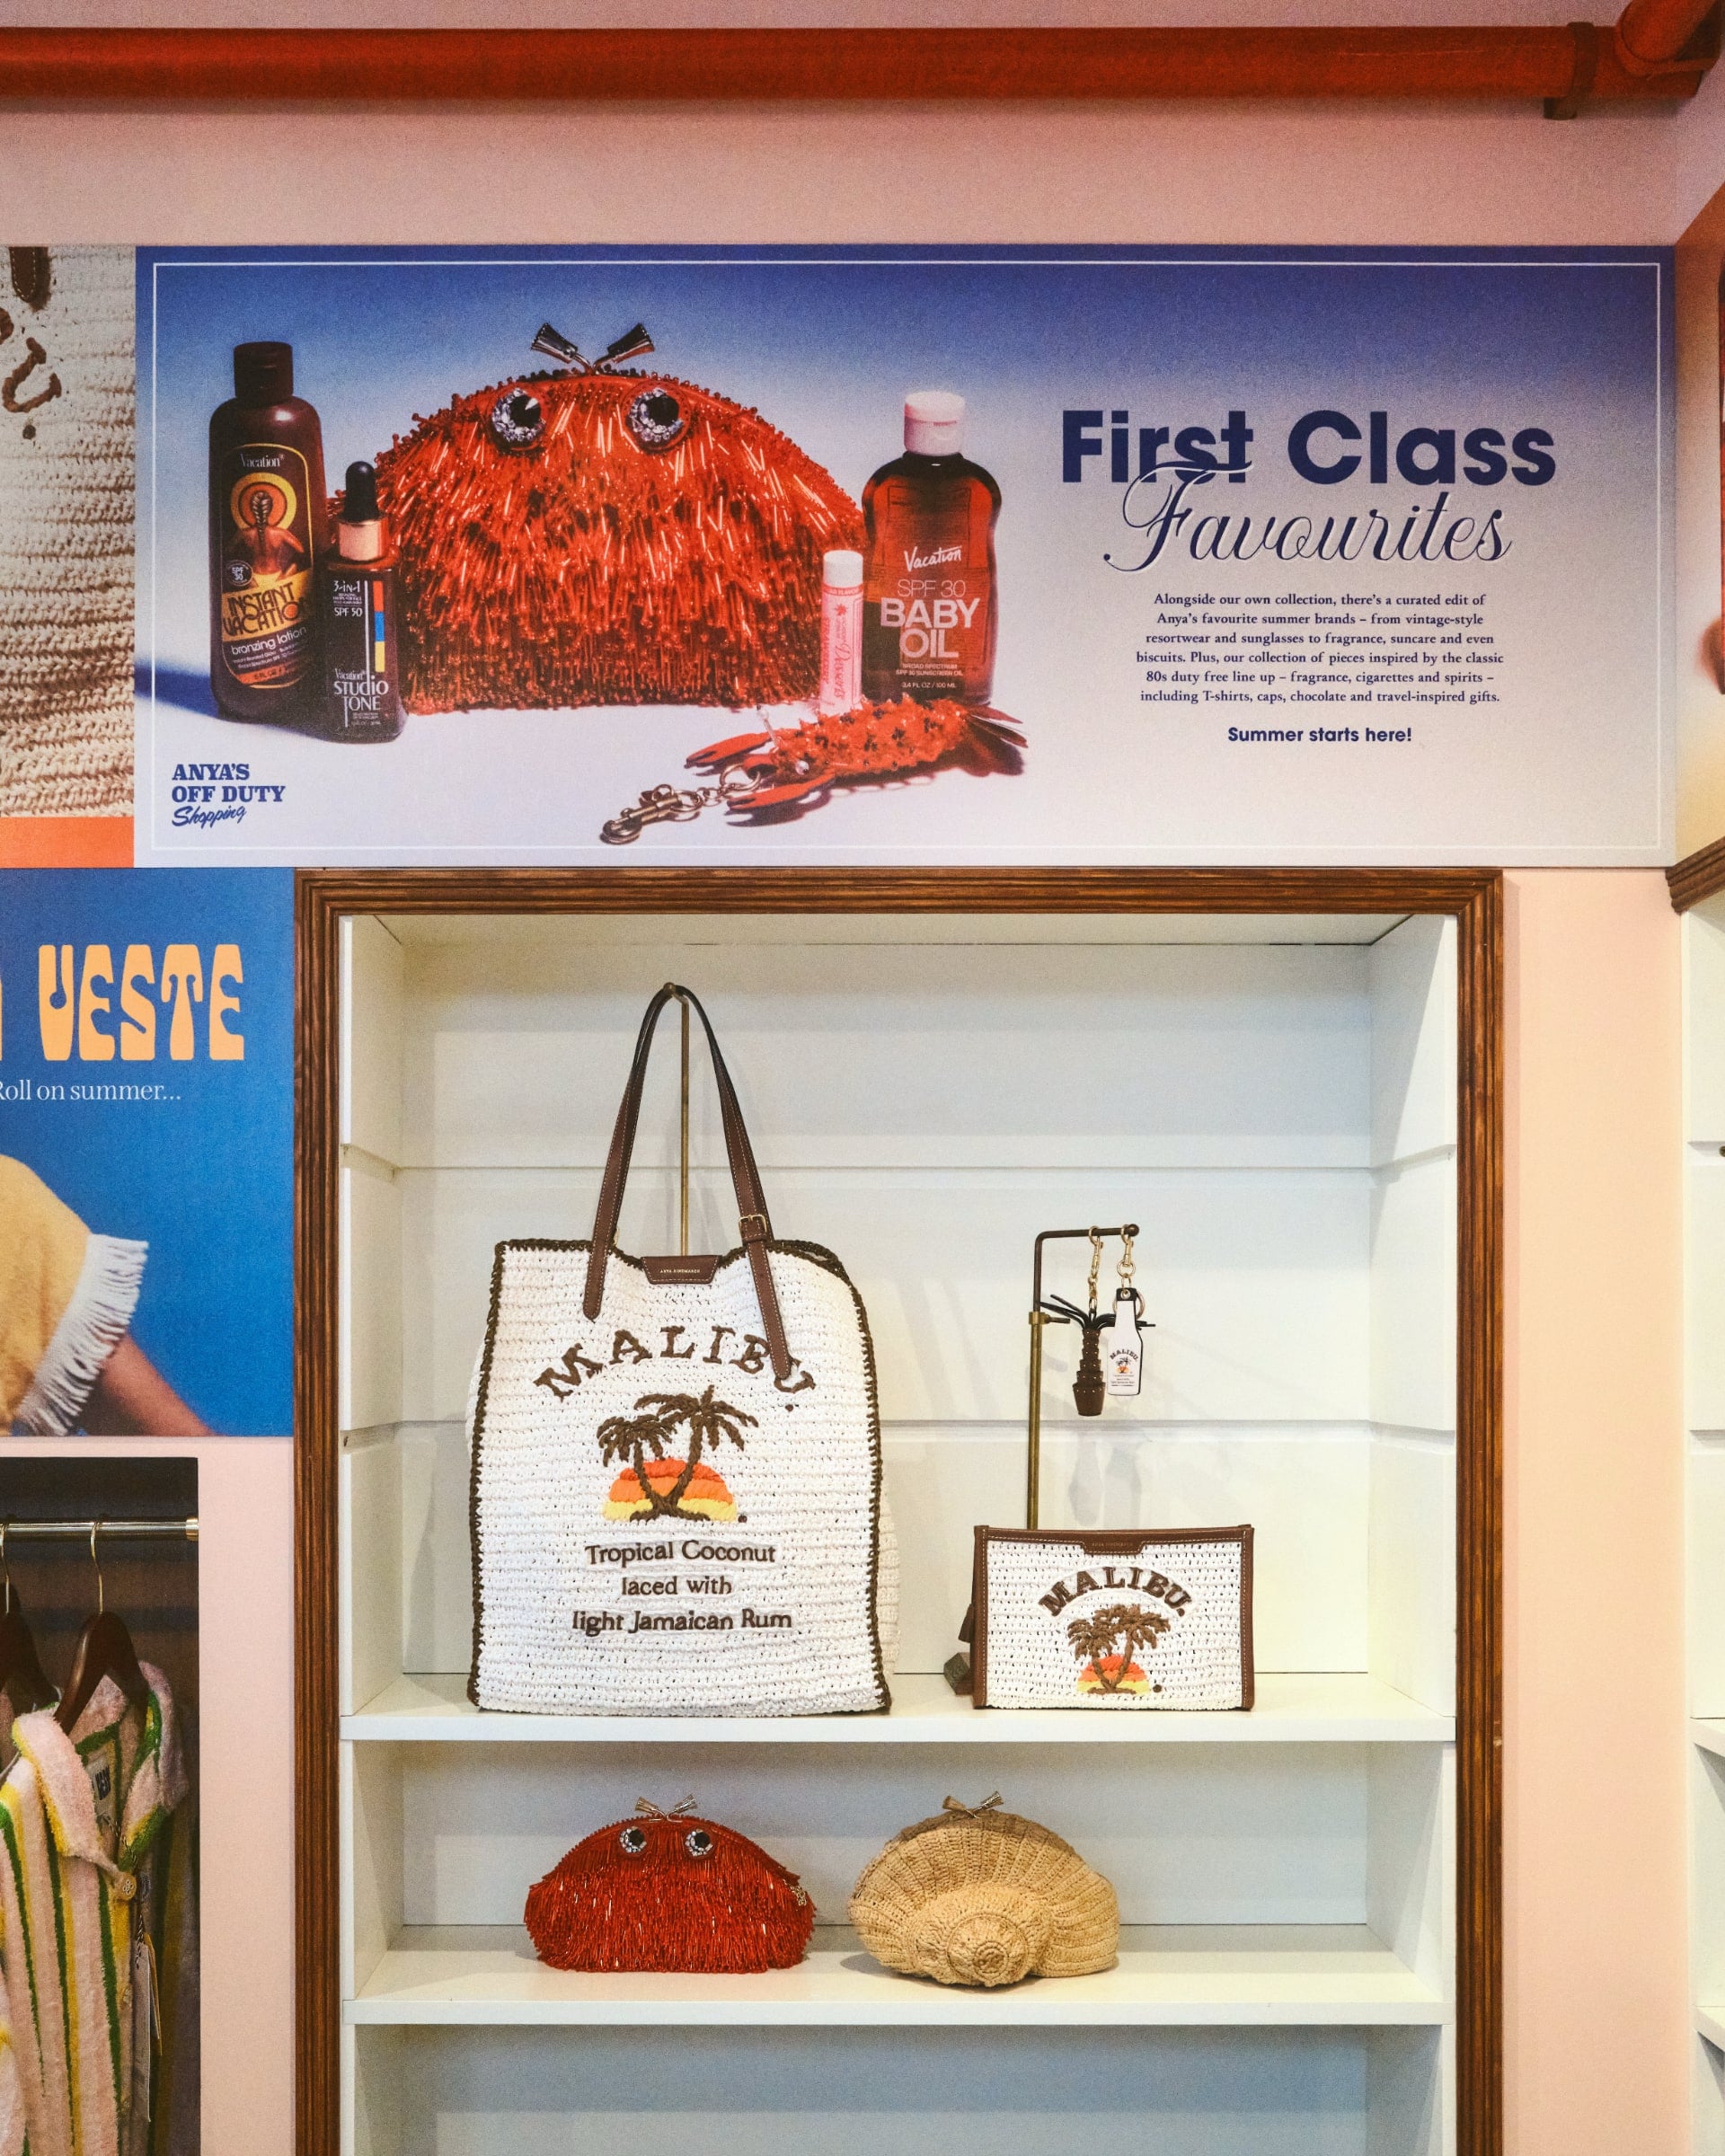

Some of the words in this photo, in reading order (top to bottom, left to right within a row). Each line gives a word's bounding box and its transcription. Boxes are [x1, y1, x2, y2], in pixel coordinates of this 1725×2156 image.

[1062, 410, 1252, 483] First
[1287, 409, 1556, 487] Class
[1103, 460, 1513, 572] Favourites
[904, 545, 962, 571] Vacation
[898, 579, 936, 597] SPF
[941, 579, 966, 597] 30
[227, 582, 295, 620] INSTANT
[1154, 592, 1216, 608] Alongside
[1219, 596, 1242, 605] our
[1243, 596, 1271, 605] own
[1274, 593, 1337, 607] collection,
[1340, 593, 1382, 605] there's
[1384, 597, 1392, 605] a
[1395, 593, 1441, 605] curated
[1444, 593, 1469, 605] edit
[1472, 593, 1487, 605] of
[334, 607, 349, 617] SPF
[351, 607, 363, 617] 50
[880, 597, 980, 628] BABY
[1156, 612, 1199, 627] Anya's
[1201, 612, 1258, 624] favourite
[1261, 616, 1311, 624] summer
[1314, 612, 1357, 624] brands
[1370, 612, 1401, 624] from
[1405, 613, 1484, 628] vintage-style
[231, 639, 276, 656] bronzing
[277, 627, 307, 648] lotion
[899, 628, 959, 658] OIL
[1146, 634, 1211, 643] resortwear
[1214, 632, 1237, 643] and
[1241, 632, 1305, 647] sunglasses
[1308, 635, 1322, 644] to
[1324, 632, 1386, 648] fragrance,
[1390, 636, 1437, 644] suncare
[1439, 632, 1463, 644] and
[1465, 636, 1494, 644] even
[1136, 650, 1186, 663] biscuits.
[1190, 650, 1220, 665] Plus,
[1223, 655, 1245, 663] our
[1248, 650, 1306, 663] collection
[1310, 650, 1325, 663] of
[1329, 651, 1365, 667] pieces
[1368, 651, 1419, 667] inspired
[1422, 651, 1438, 667] by
[1442, 651, 1463, 664] the
[1465, 651, 1504, 664] classic
[1146, 670, 1168, 683] 80s
[1171, 670, 1200, 685] duty
[1204, 670, 1229, 683] free
[1233, 670, 1256, 683] line
[1260, 674, 1276, 685] up
[1290, 670, 1352, 685] fragrance,
[1355, 671, 1414, 685] cigarettes
[1418, 670, 1440, 683] and
[1444, 671, 1483, 685] spirits
[1140, 689, 1199, 705] including
[1202, 689, 1253, 702] T-shirts,
[1257, 694, 1287, 705] caps,
[1289, 689, 1347, 702] chocolate
[1349, 690, 1373, 702] and
[1376, 690, 1465, 705] travel-inspired
[1469, 690, 1500, 705] gifts.
[1227, 726, 1305, 742] Summer
[1308, 727, 1360, 742] starts
[1365, 727, 1412, 743] here!
[172, 764, 250, 781] ANYA'S
[172, 785, 216, 802] OFF
[221, 785, 286, 802] DUTY
[172, 805, 247, 829] Shopping
[36, 1085, 65, 1100] on
[70, 1083, 181, 1100] summer...
[1110, 1348, 1139, 1360] MALIBU
[585, 1542, 674, 1568] Tropical
[682, 1540, 776, 1562] Coconut
[622, 1576, 677, 1595] laced
[686, 1576, 732, 1595] with
[1039, 1566, 1192, 1617] MALIBU
[572, 1611, 624, 1637] light
[629, 1610, 733, 1633] Jamaican
[741, 1608, 792, 1628] Rum
